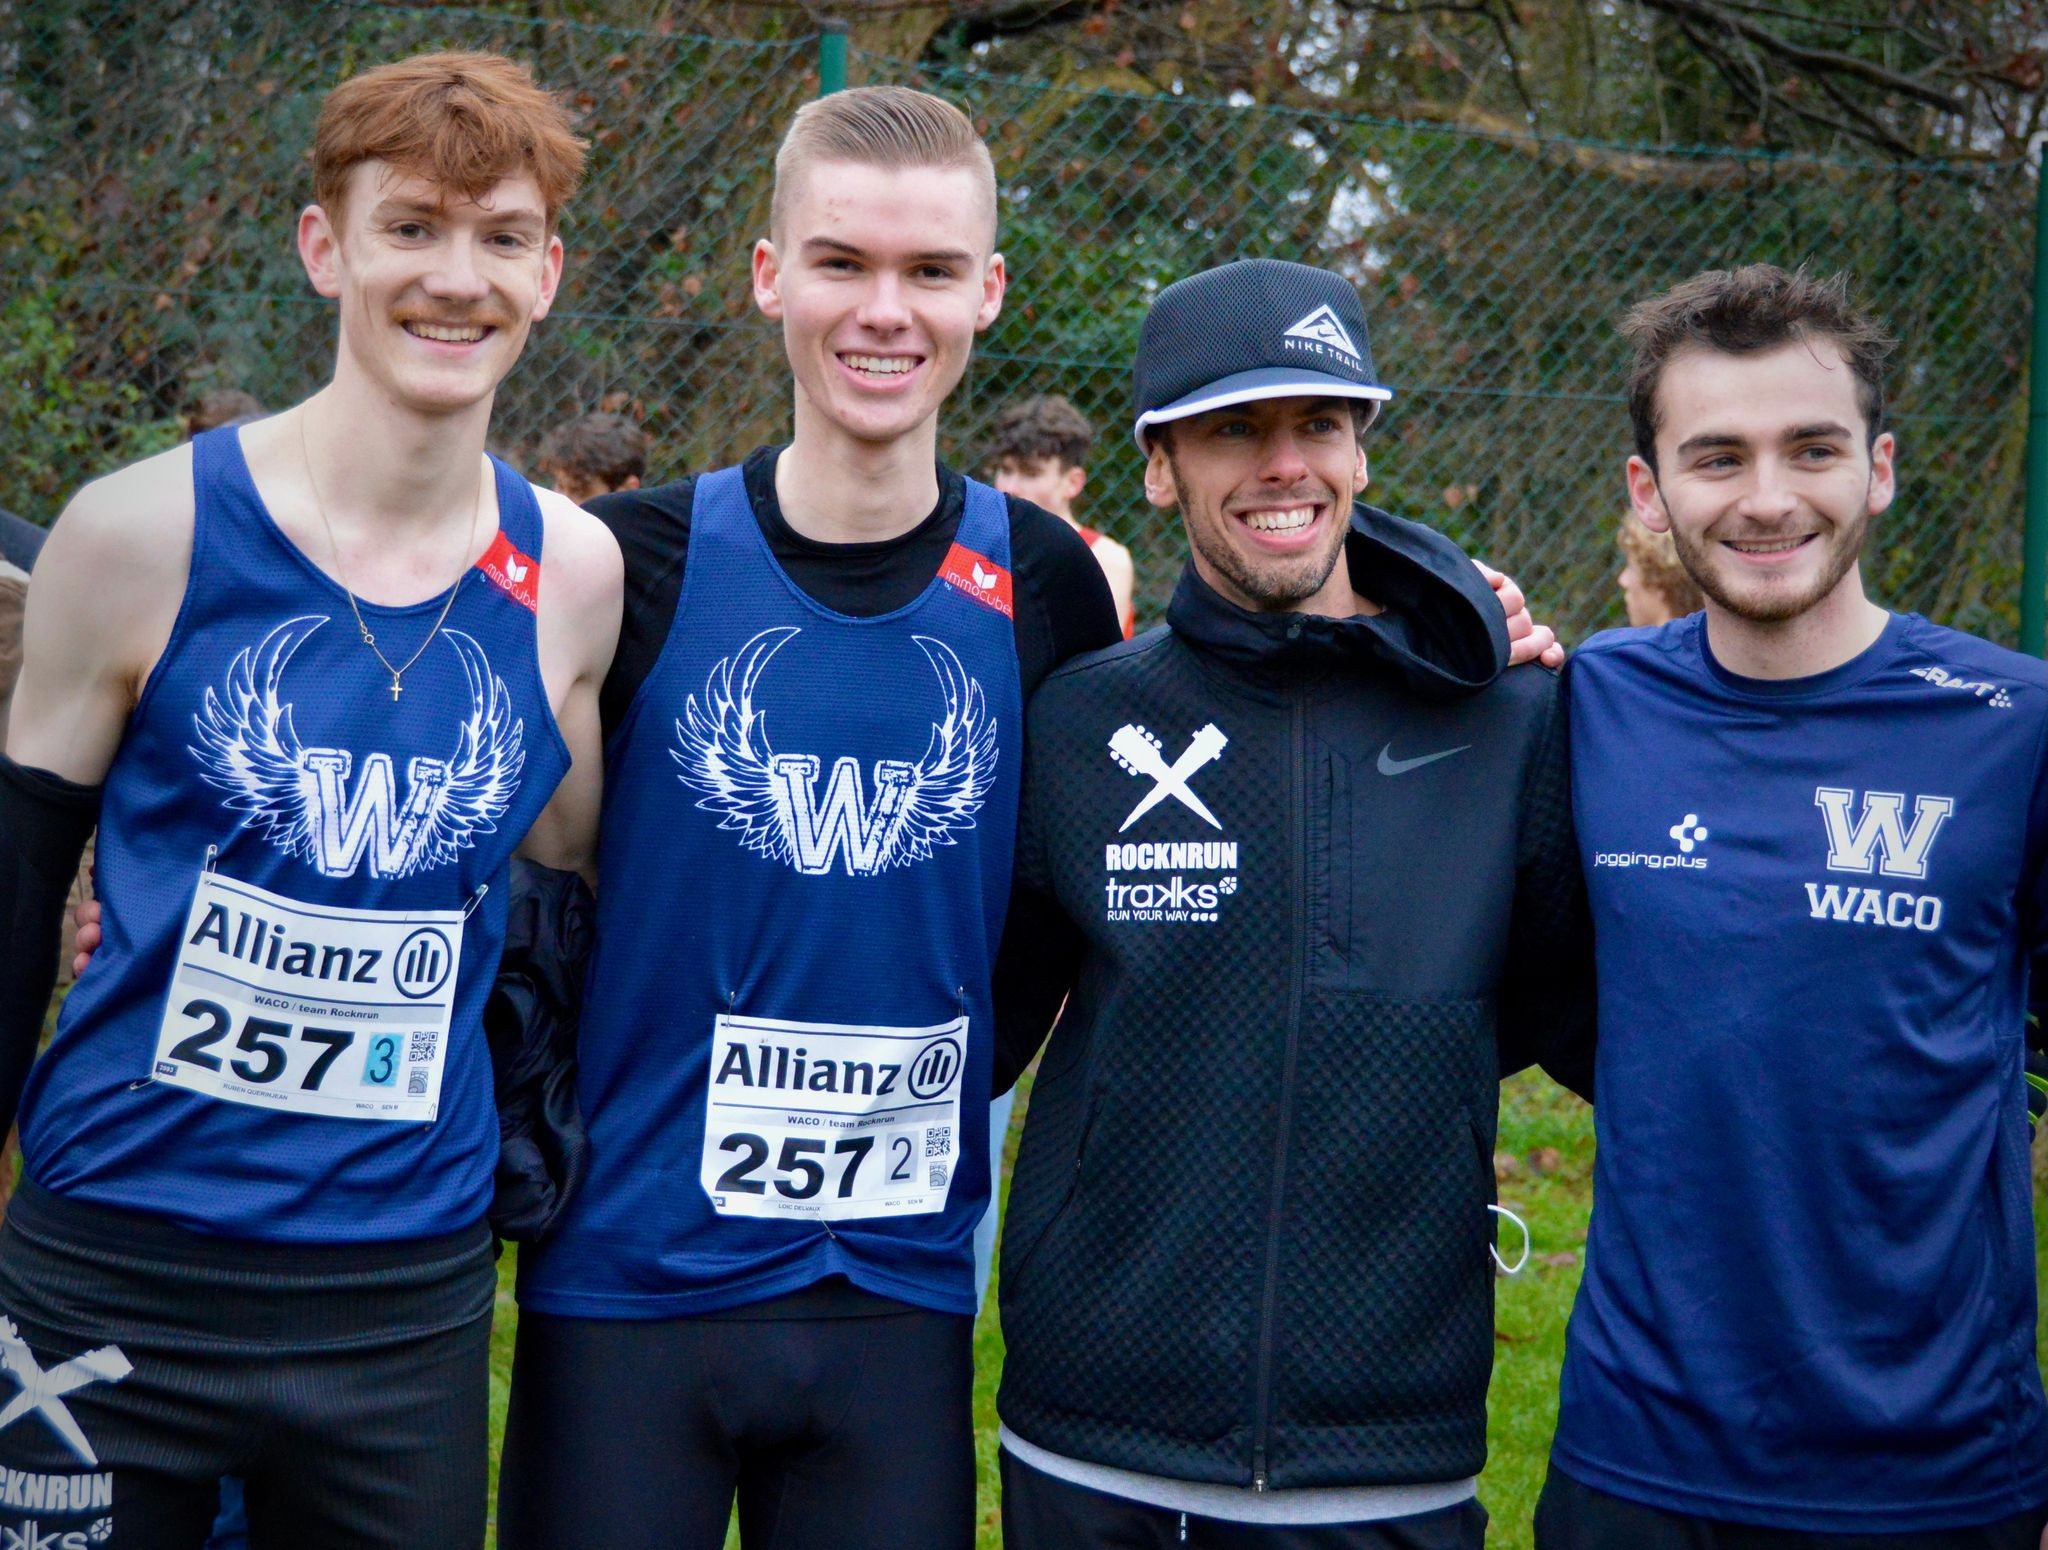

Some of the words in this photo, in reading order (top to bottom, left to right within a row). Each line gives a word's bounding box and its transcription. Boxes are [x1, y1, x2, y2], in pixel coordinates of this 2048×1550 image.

[1285, 340, 1323, 354] NIKE
[1328, 348, 1363, 372] TRAIL
[484, 563, 537, 612] mmocube
[946, 567, 1011, 615] immocube
[302, 747, 449, 880] W
[773, 754, 916, 876] W
[1814, 786, 1954, 880] W
[1106, 842, 1237, 871] ROCKNRUN
[1105, 876, 1218, 909] trakks
[1107, 910, 1129, 921] RUN
[1133, 910, 1162, 921] YOUR
[1165, 910, 1189, 921] WAY
[1804, 882, 1942, 932] WACO
[189, 902, 383, 984] Allianz
[254, 994, 289, 1009] WACO
[299, 1004, 327, 1015] team
[330, 1007, 379, 1019] Rocknrun
[169, 999, 355, 1091] 257
[369, 1038, 395, 1083] 3
[223, 1083, 246, 1094] RUBEN
[715, 1041, 902, 1096] Allianz
[787, 1115, 820, 1126] WACO
[829, 1119, 855, 1128] team
[857, 1116, 895, 1127] Rocknrun
[715, 1132, 875, 1200] 257
[890, 1137, 912, 1180] 2
[0, 1519, 88, 1550] kks
